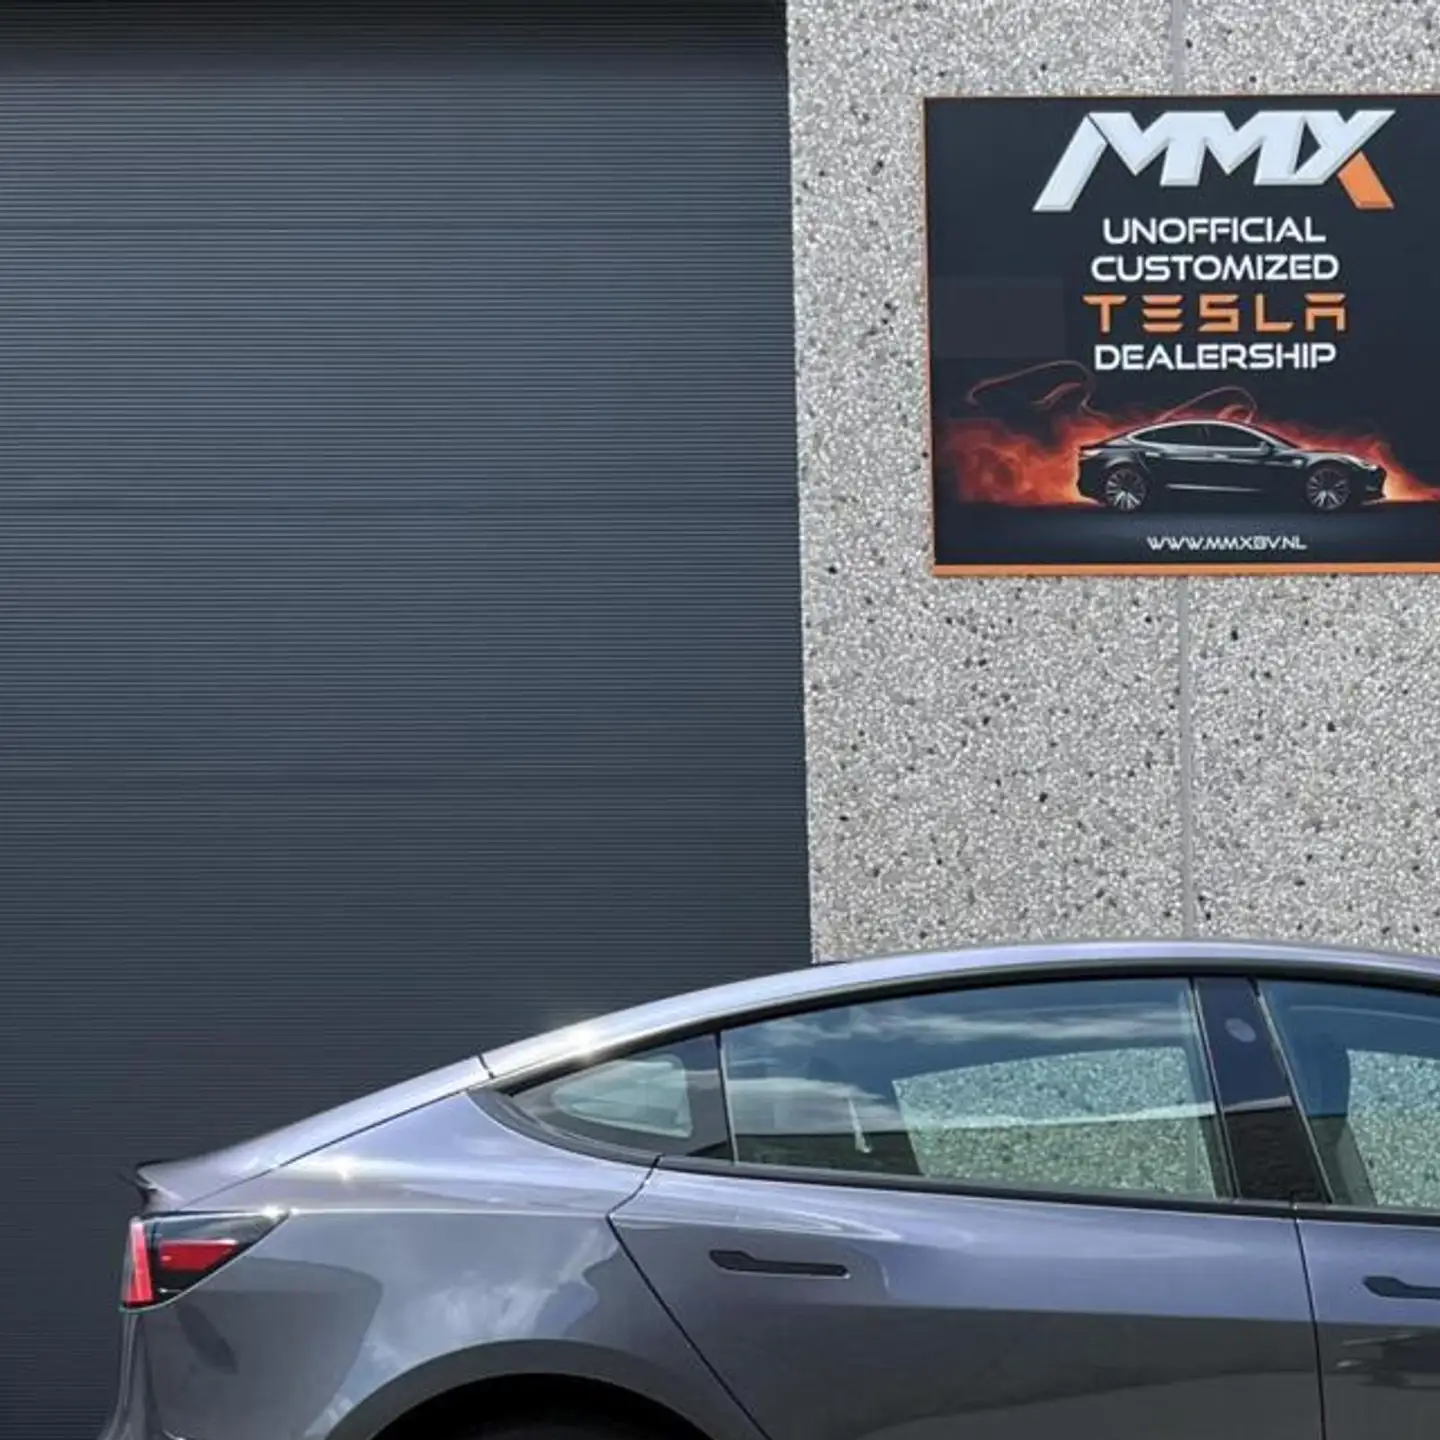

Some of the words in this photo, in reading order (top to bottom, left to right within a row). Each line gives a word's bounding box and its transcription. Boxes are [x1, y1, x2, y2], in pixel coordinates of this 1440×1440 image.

[1032, 109, 1396, 212] MMX
[1102, 216, 1327, 245] UNOFFICIAL
[1090, 253, 1340, 282] CUSTOMIZED
[1083, 293, 1346, 332] TESLA
[1094, 342, 1337, 371] DEALERSHIP
[1146, 535, 1307, 551] WWW.MMXBV.NL
